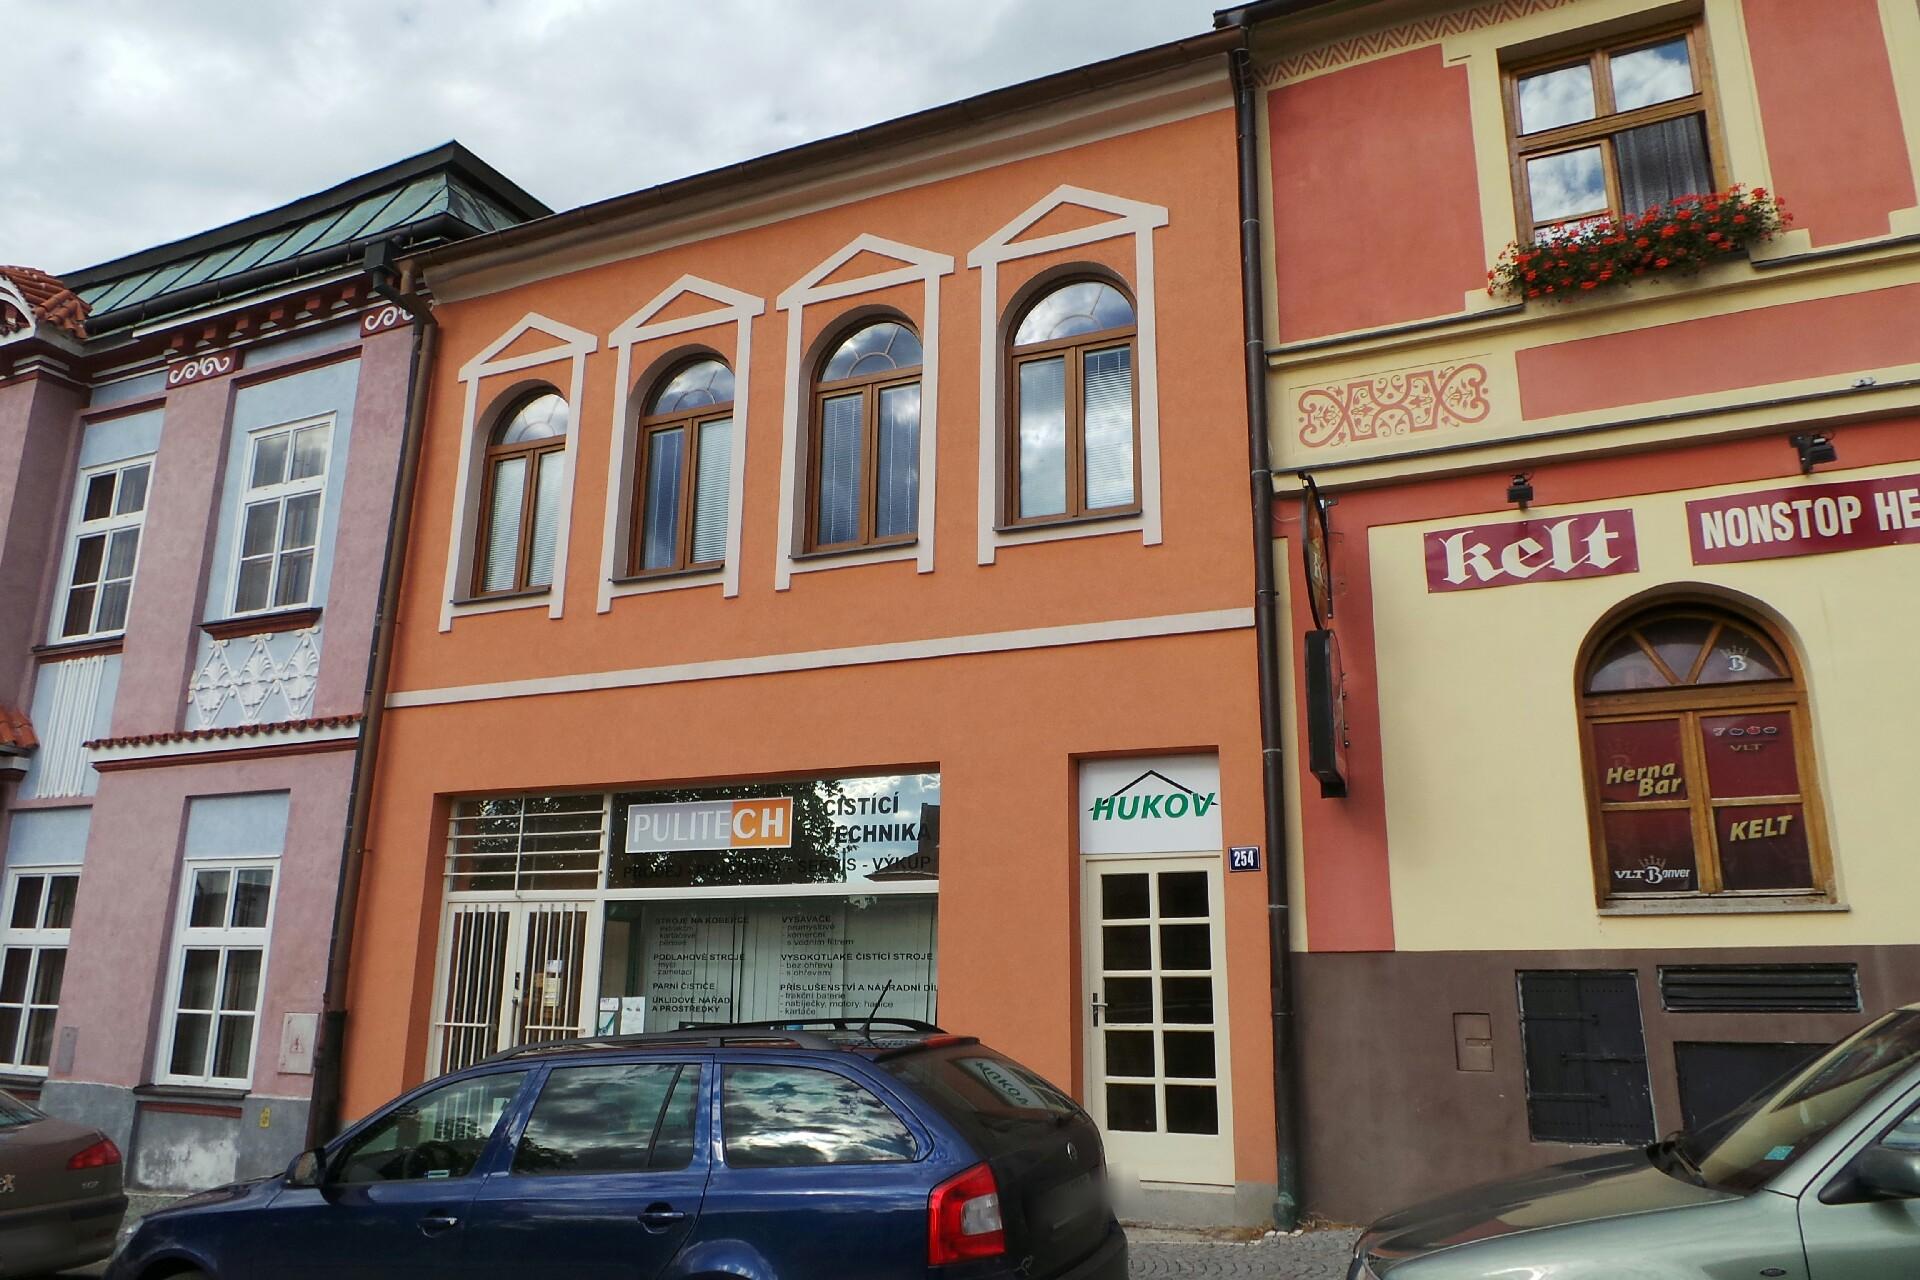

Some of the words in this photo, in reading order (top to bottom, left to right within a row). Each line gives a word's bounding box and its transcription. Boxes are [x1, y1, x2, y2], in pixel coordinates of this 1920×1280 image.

[1701, 495, 1862, 550] NONSTOP
[1873, 488, 1920, 531] HE
[1438, 518, 1622, 585] kelt
[1730, 743, 1763, 752] VLT
[1606, 762, 1677, 785] Herna
[1638, 776, 1683, 798] Bar
[1092, 792, 1216, 821] HUKOV
[633, 806, 784, 843] PULITECH
[1729, 815, 1793, 842] KELT
[1233, 850, 1255, 867] 254
[1614, 869, 1645, 879] VLT
[654, 952, 707, 961] PODLAHOVÉ
[709, 952, 745, 961] STROJE
[893, 952, 933, 961] STROJE
[780, 982, 856, 992] PŘÍSLUŠENSTVÍ
[858, 984, 865, 992] A
[652, 1005, 658, 1013] A
[660, 1004, 720, 1013] PROSTŘEDKY
